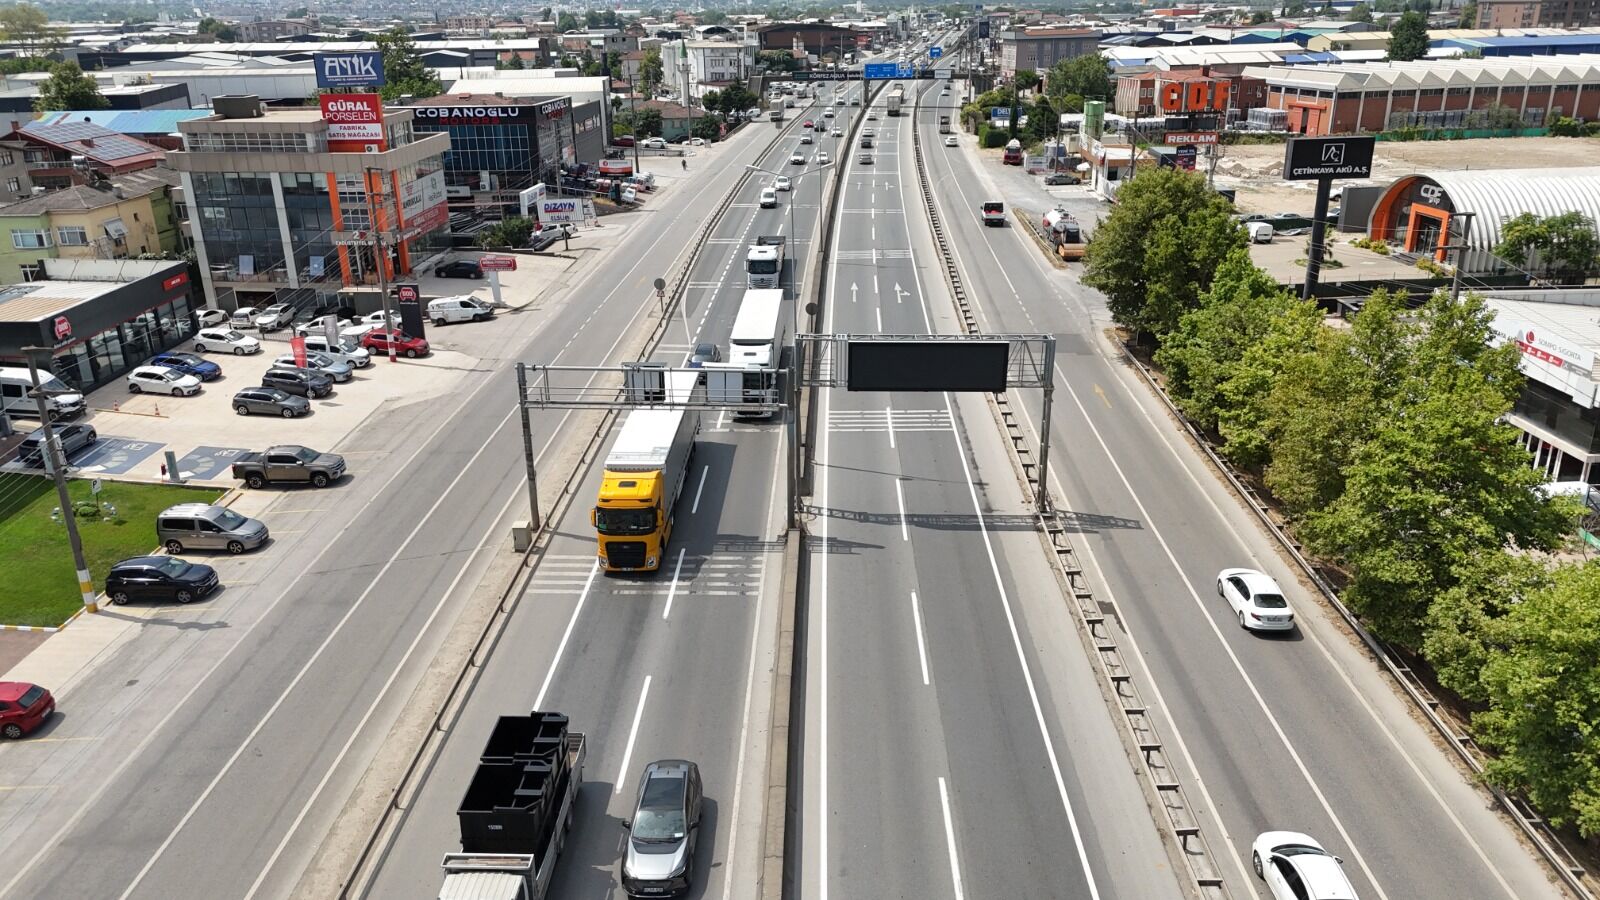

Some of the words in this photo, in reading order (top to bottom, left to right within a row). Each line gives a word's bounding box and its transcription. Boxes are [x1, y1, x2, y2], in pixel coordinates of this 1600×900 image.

[328, 100, 371, 111] GÜRAL
[325, 112, 376, 121] PORSELEN
[1168, 134, 1216, 143] REKLAM
[1293, 166, 1334, 176] ÇETİNKAYA
